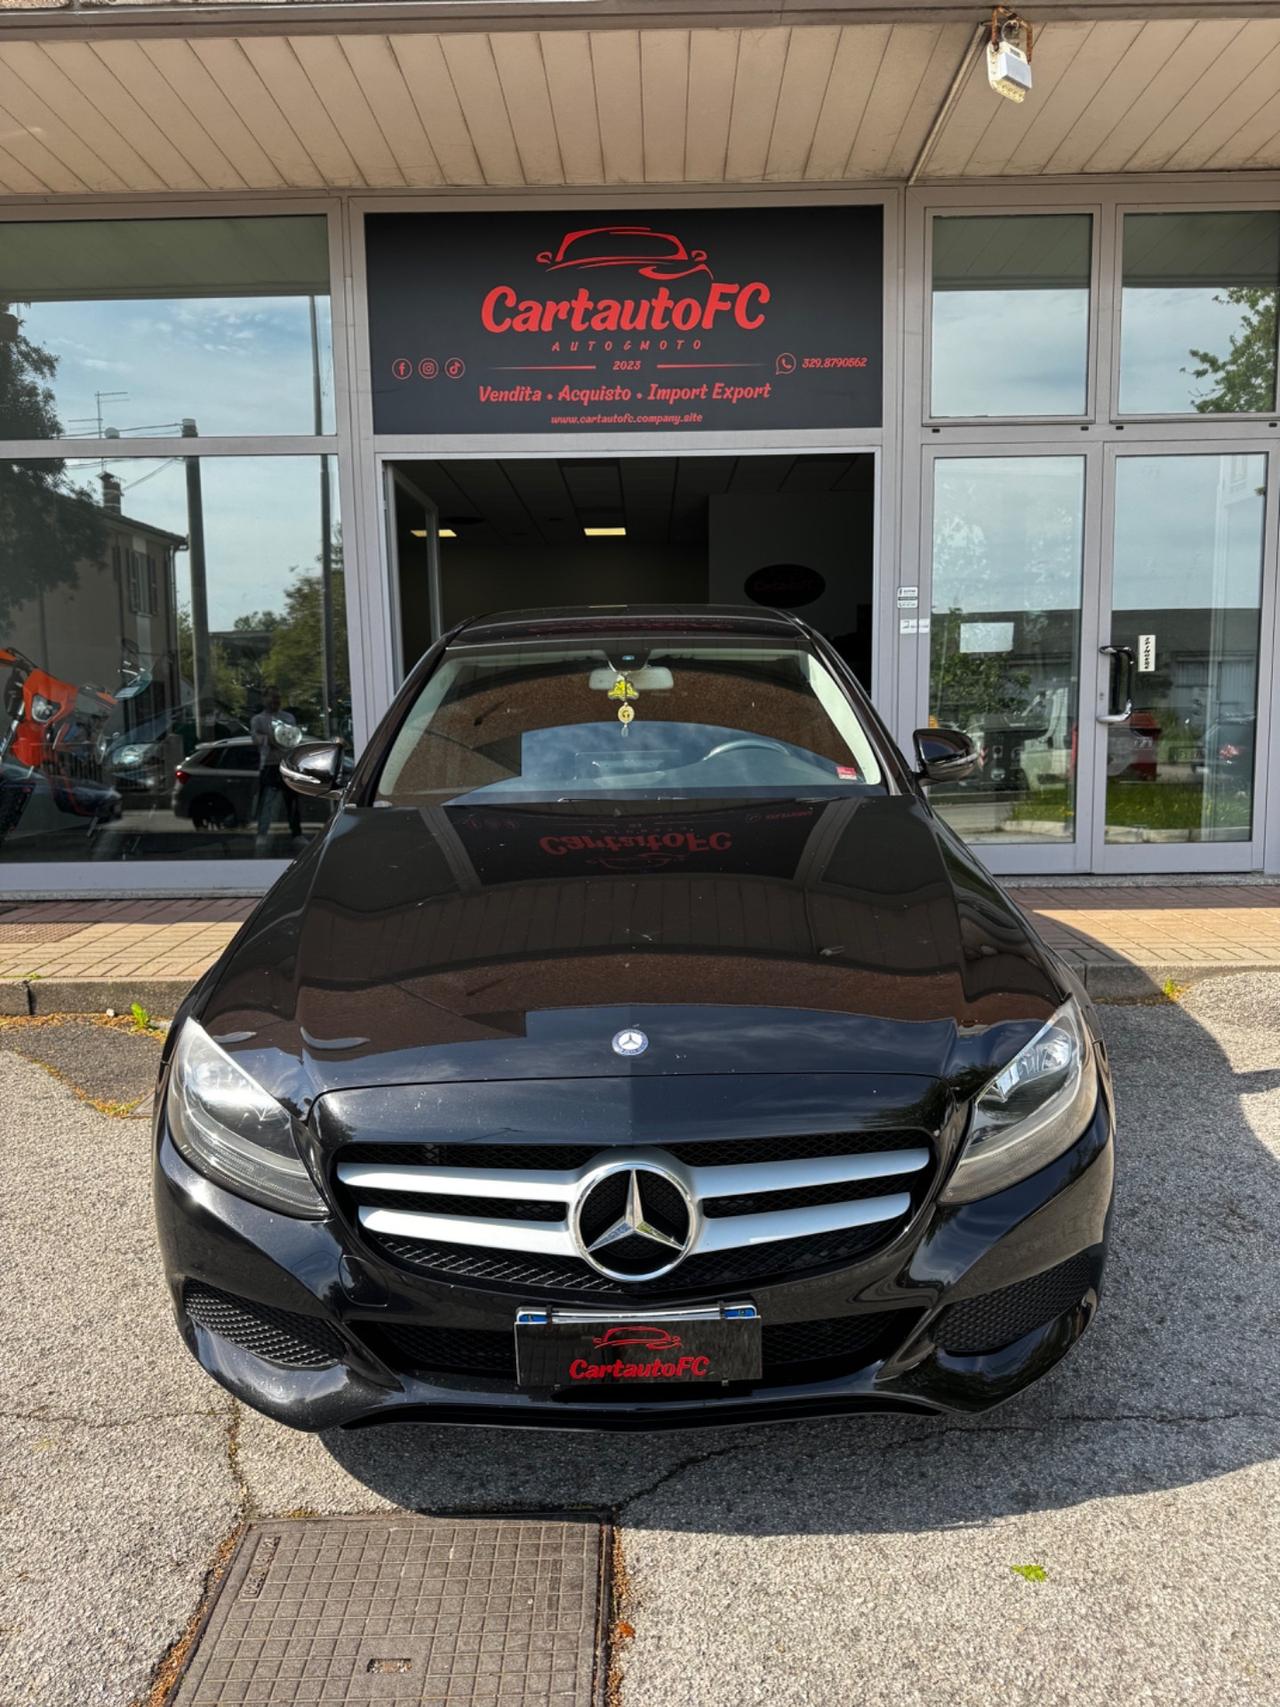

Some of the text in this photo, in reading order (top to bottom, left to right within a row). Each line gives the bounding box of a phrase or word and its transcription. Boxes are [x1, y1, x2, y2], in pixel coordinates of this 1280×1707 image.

[481, 281, 771, 333] CartautoFC
[612, 360, 642, 371] 2023
[479, 382, 772, 406] Vendita Acquisto Import Export
[550, 412, 703, 425] www.cartautofc.company.site
[569, 1355, 710, 1379] CartautoFC
